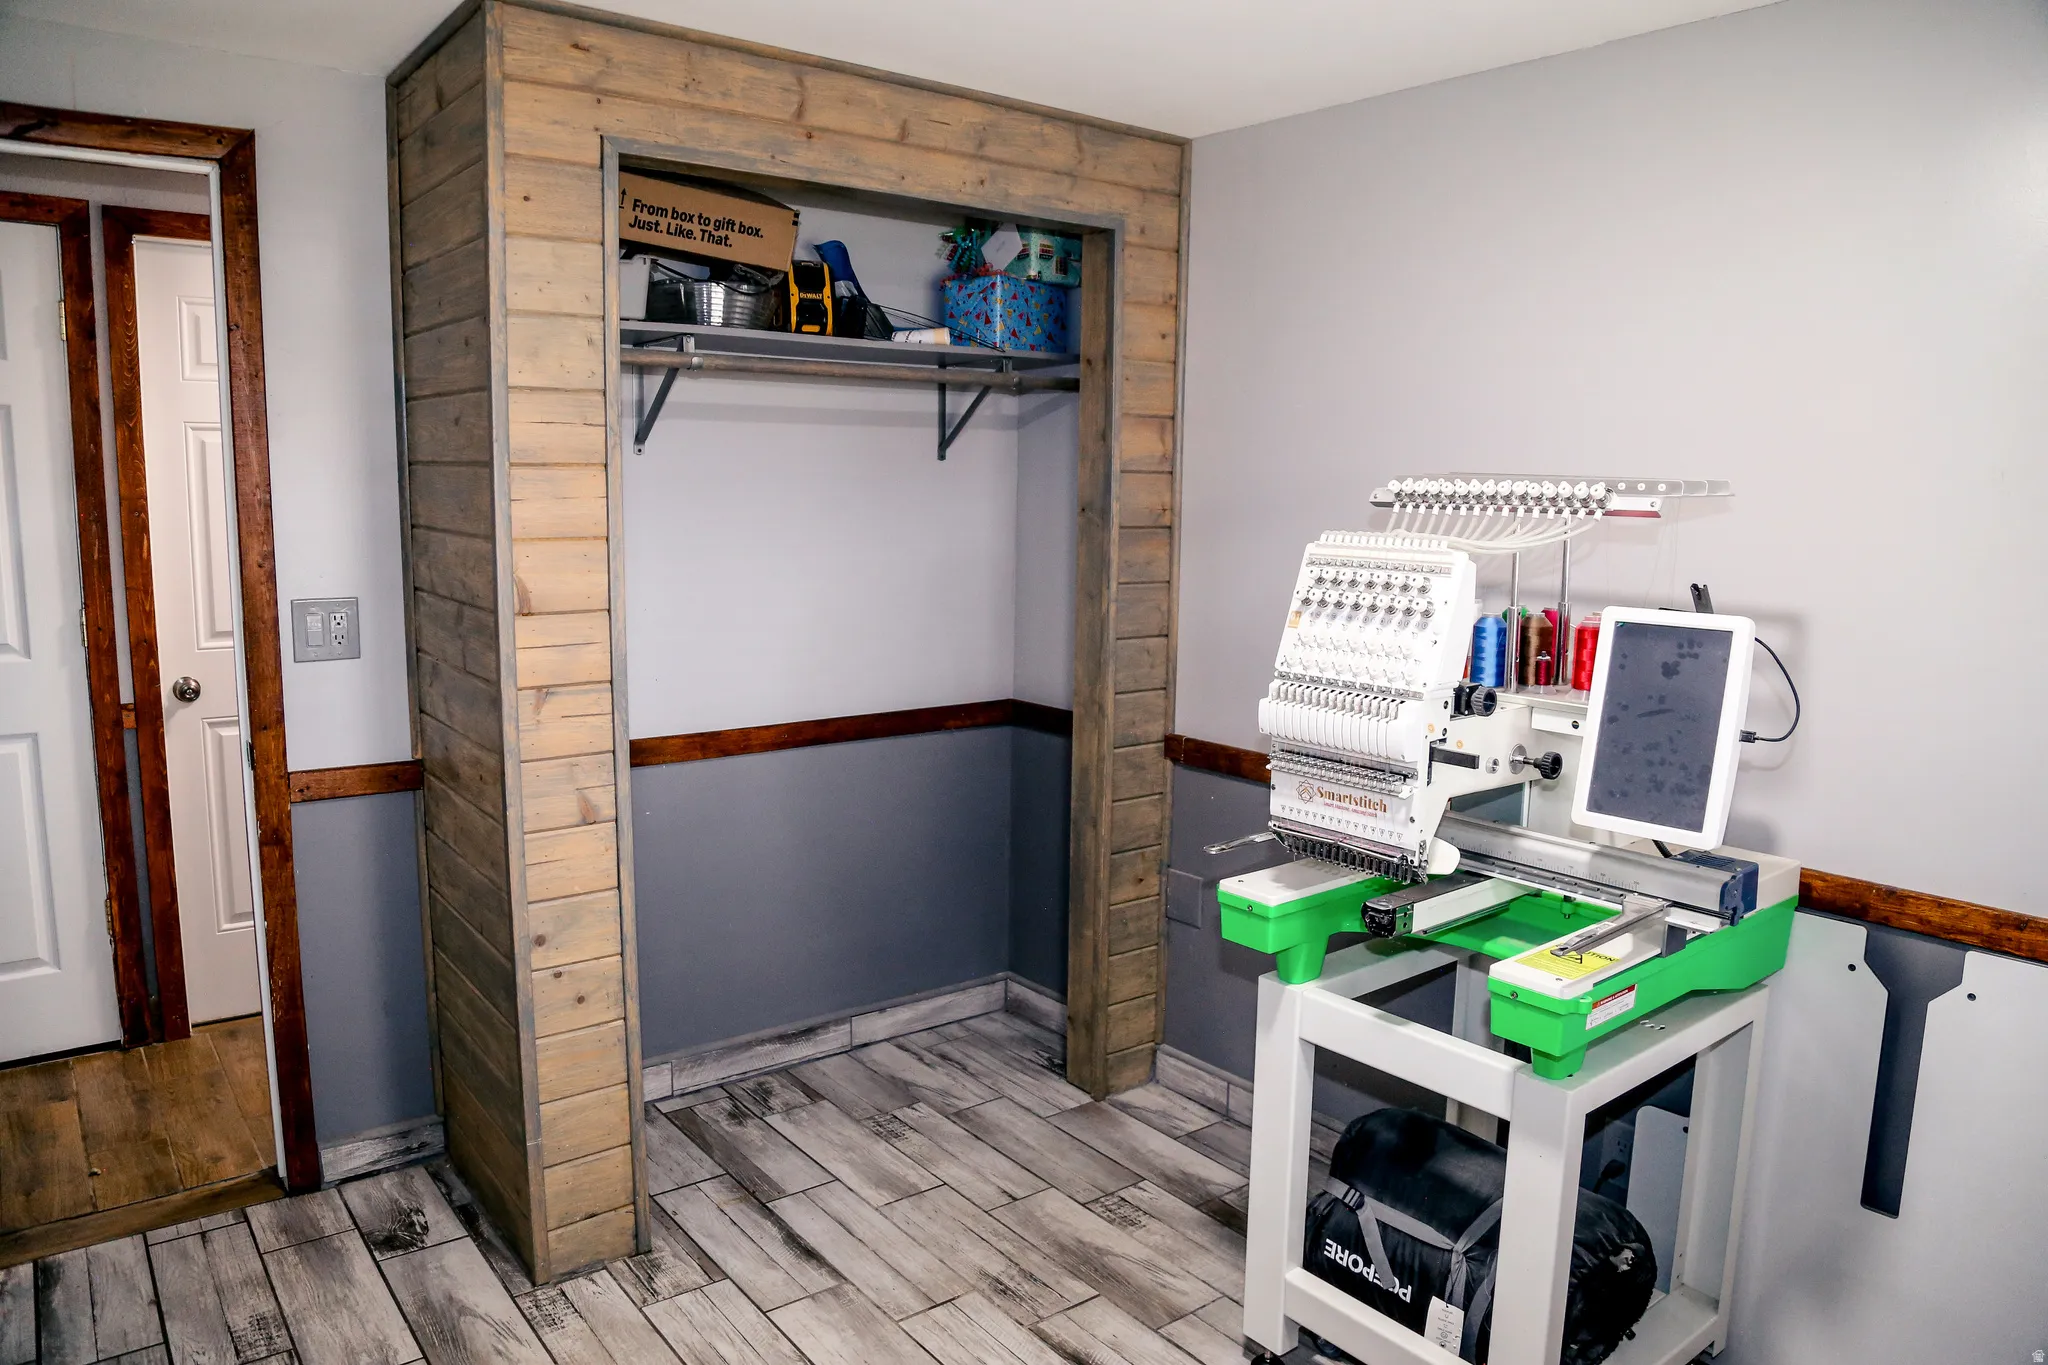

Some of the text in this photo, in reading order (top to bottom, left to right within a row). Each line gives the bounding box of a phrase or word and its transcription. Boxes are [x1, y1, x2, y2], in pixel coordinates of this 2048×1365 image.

[628, 215, 733, 248] Just. Like. That.
[632, 198, 764, 239] From box to gift box.
[1316, 785, 1388, 814] Smartstitch
